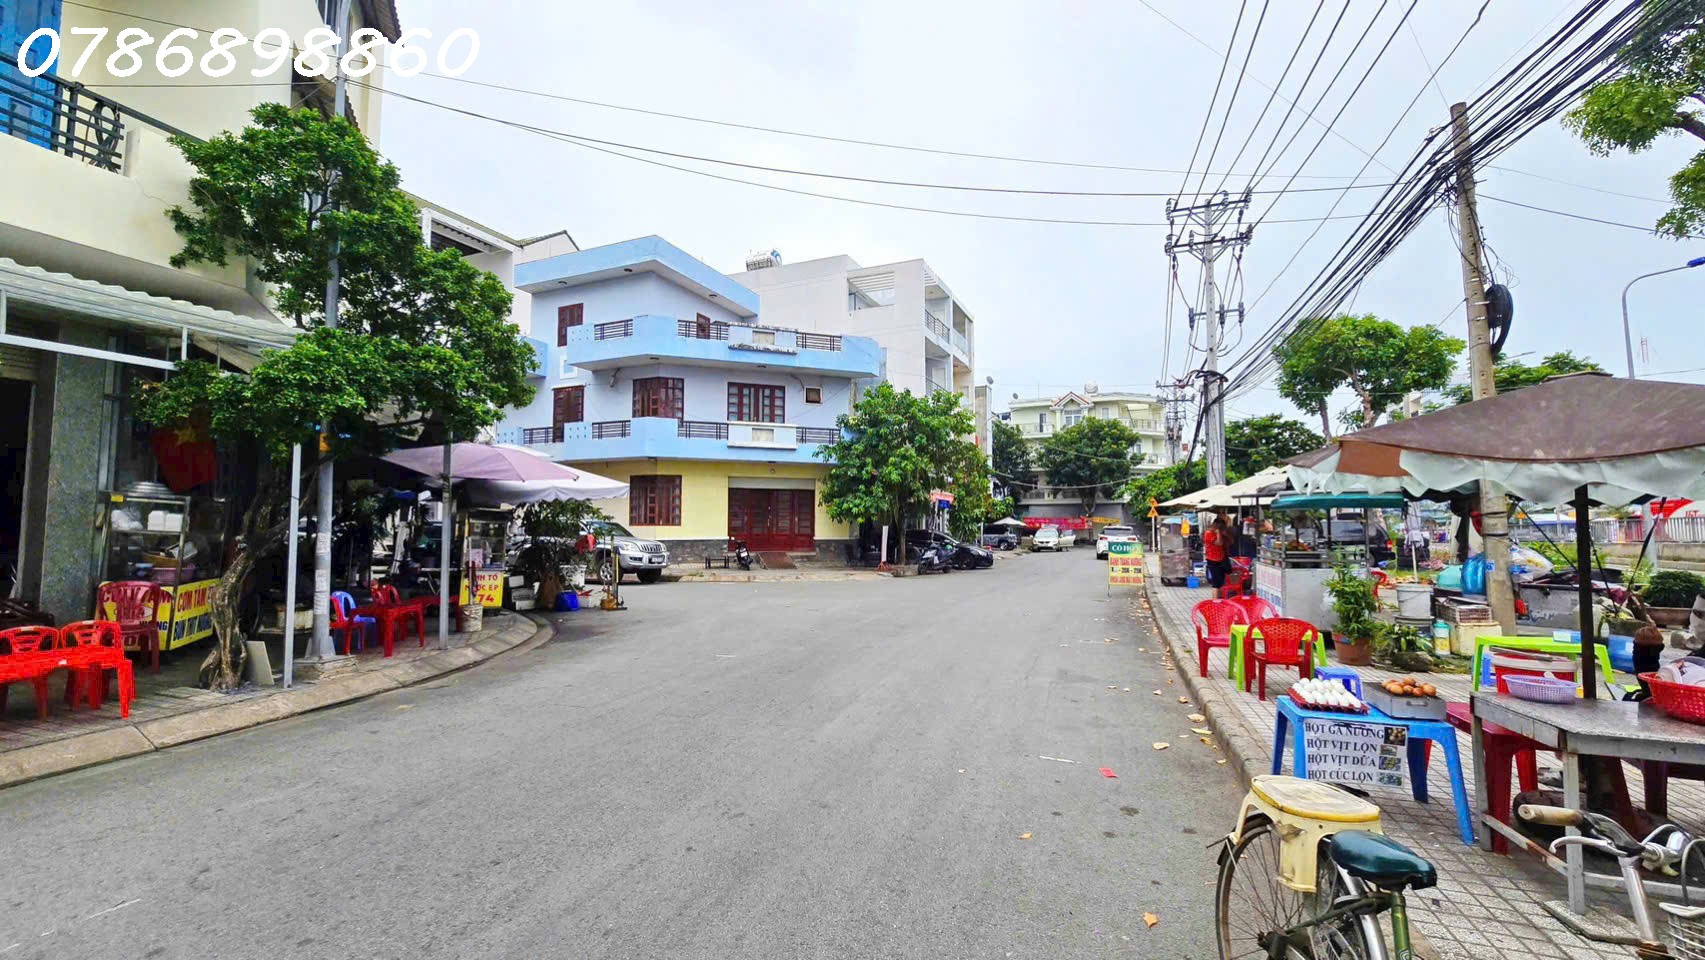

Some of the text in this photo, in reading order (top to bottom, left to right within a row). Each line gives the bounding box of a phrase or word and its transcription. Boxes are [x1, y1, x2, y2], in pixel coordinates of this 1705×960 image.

[1331, 739, 1351, 752] VỊT
[1331, 754, 1351, 767] VỊT
[1329, 767, 1350, 780] CÚC
